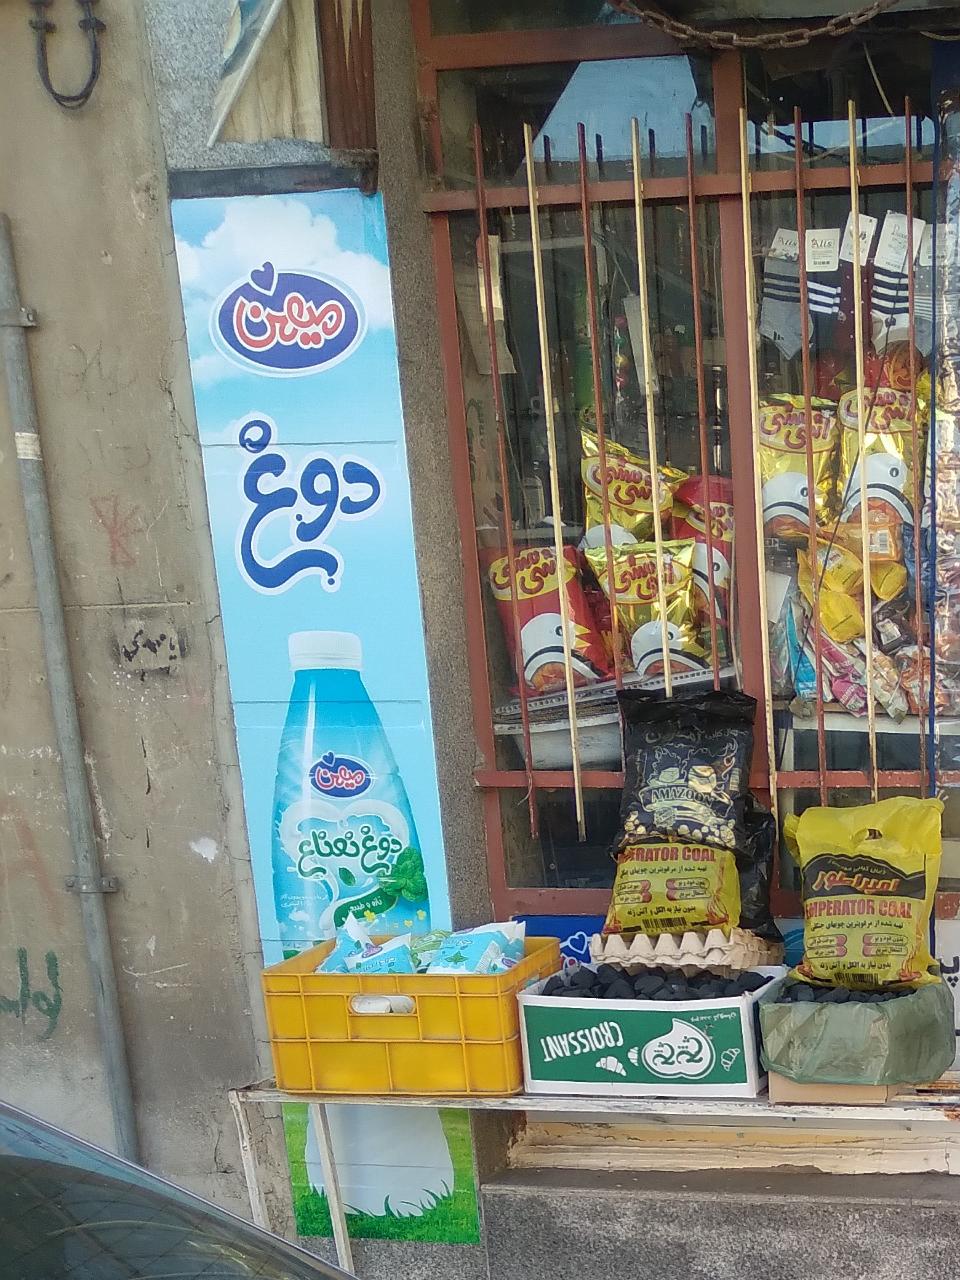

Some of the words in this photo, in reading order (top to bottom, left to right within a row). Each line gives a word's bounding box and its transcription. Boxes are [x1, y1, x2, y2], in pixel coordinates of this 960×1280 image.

[235, 293, 344, 350] میهن
[238, 419, 381, 589] دوغ
[315, 766, 367, 790] میهن
[298, 830, 360, 878] نعناع
[361, 826, 403, 874] دوغ
[681, 845, 717, 863] COAL
[878, 899, 913, 918] COAL
[540, 1021, 625, 1062] CROISSANT
